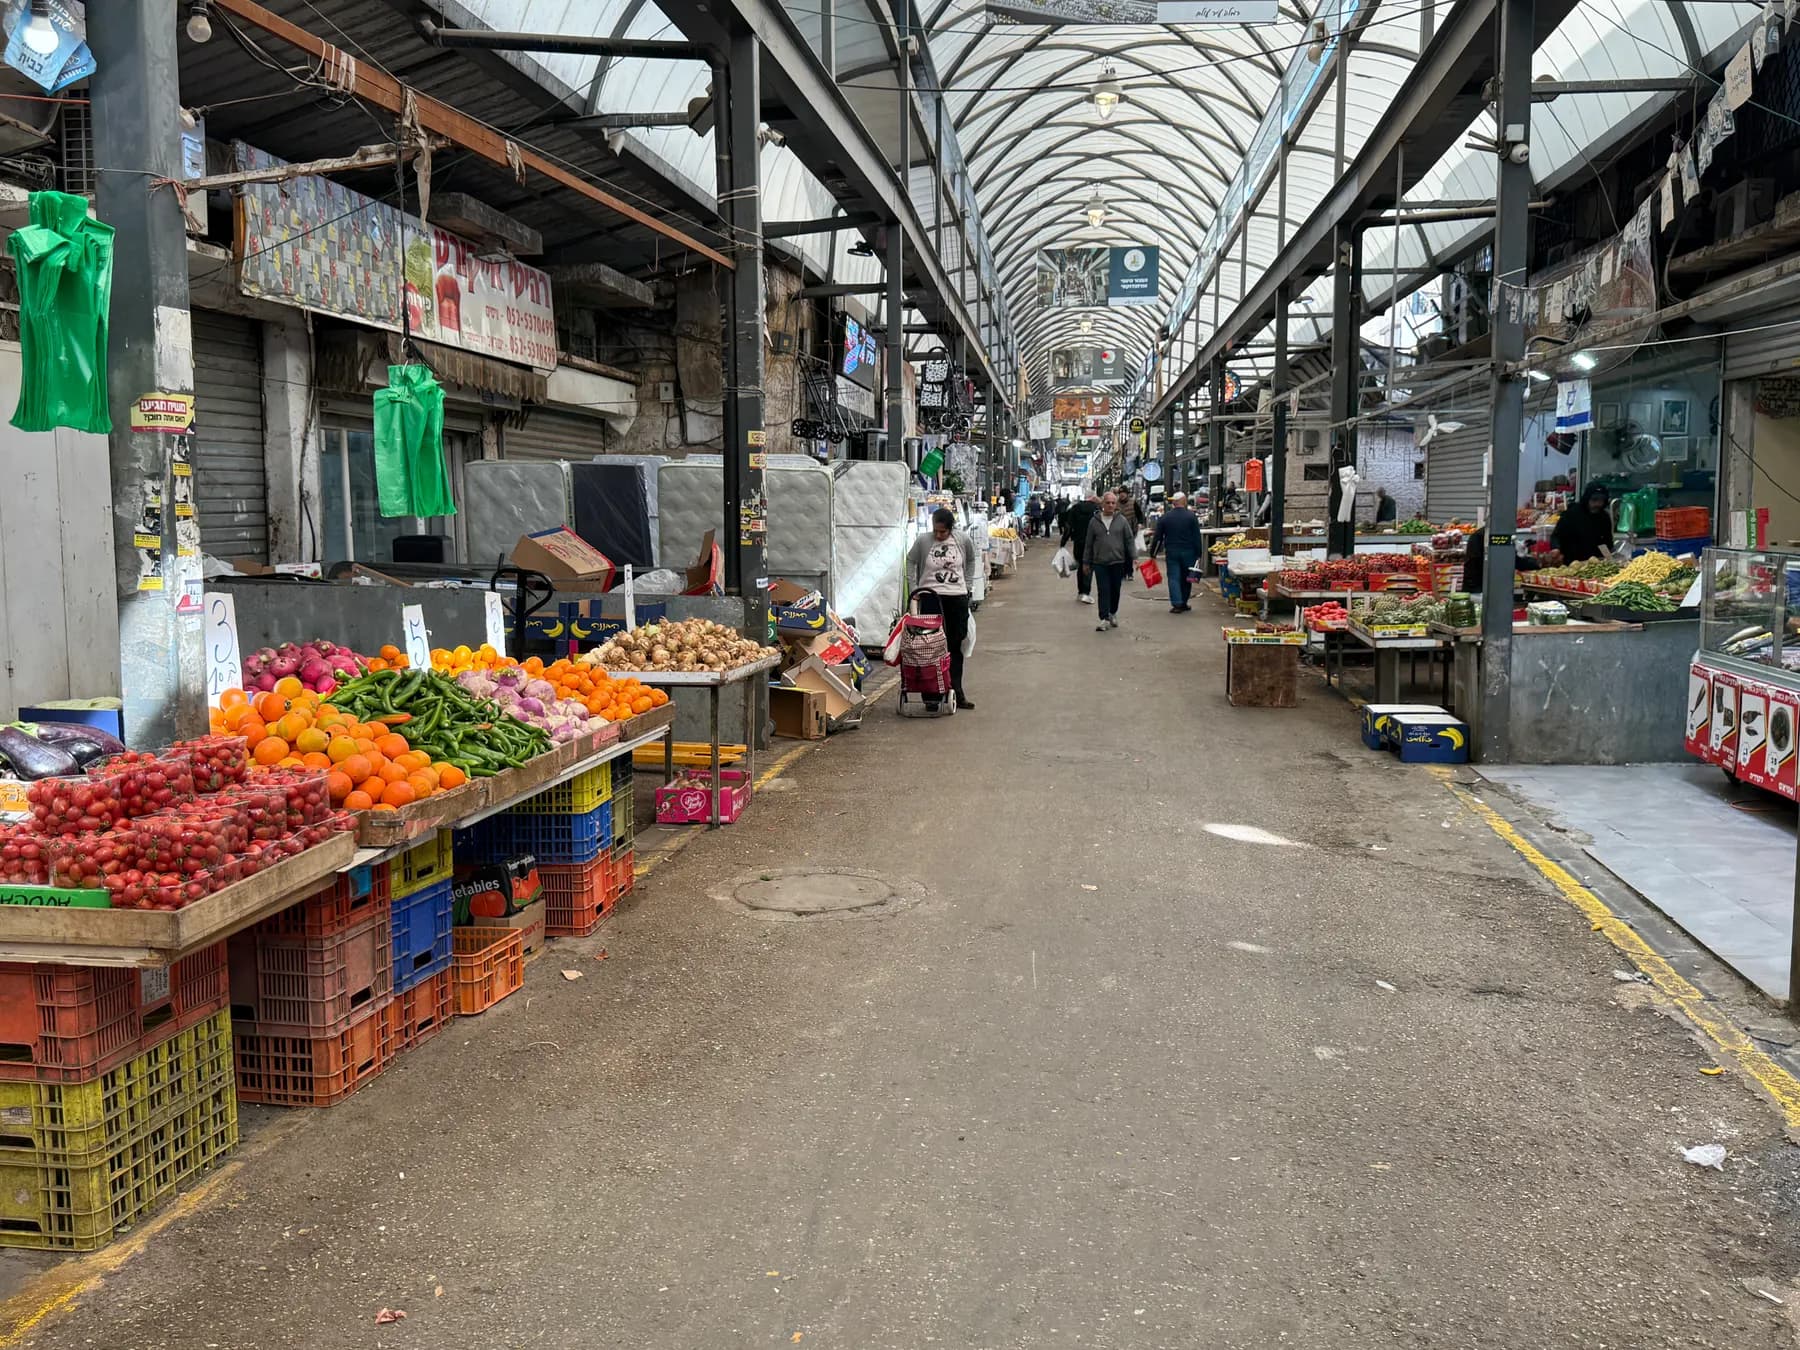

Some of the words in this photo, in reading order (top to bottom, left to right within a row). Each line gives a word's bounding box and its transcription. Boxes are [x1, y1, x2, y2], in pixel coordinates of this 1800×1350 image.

[167, 402, 186, 413] משיח
[211, 599, 234, 663] 3
[409, 618, 425, 666] 5
